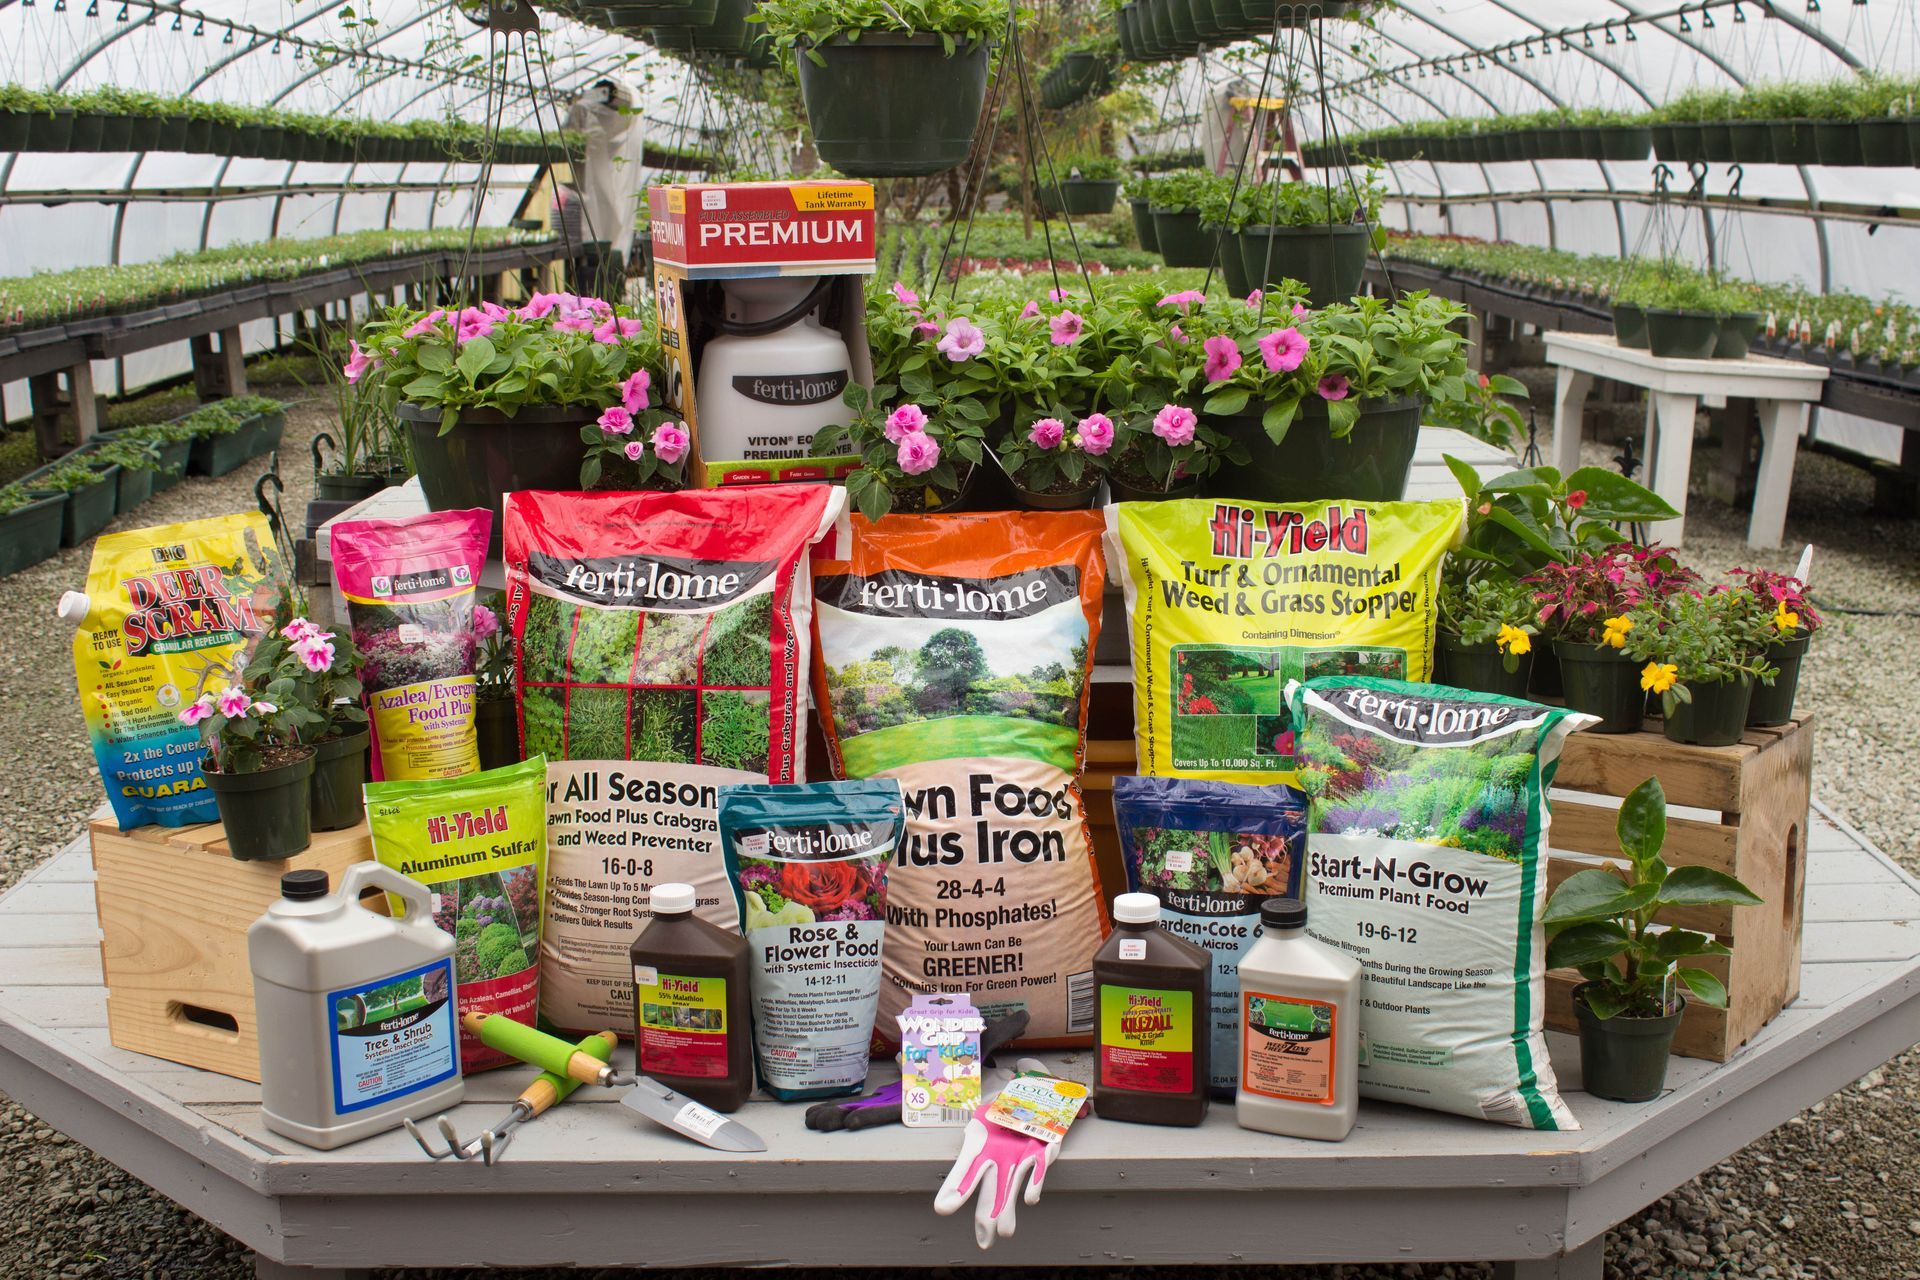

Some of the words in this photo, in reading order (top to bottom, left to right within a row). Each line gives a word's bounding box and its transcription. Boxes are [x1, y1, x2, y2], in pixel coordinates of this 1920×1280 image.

[805, 201, 825, 209] Tank
[827, 199, 867, 209] Warranty
[817, 191, 853, 199] Lifetime
[700, 211, 731, 221] FULLY
[730, 210, 790, 221] ASSEMBLED
[652, 219, 684, 247] PREMIUM
[700, 219, 863, 247] PREMIUM
[744, 449, 804, 460] PREMIUM
[1181, 560, 1231, 588] Turf
[1237, 564, 1257, 588] &
[1264, 561, 1400, 588] Ornamental
[121, 564, 231, 612] DEER
[1161, 580, 1229, 615] Weed
[1235, 591, 1256, 616] &
[1261, 590, 1325, 615] Grass
[1331, 589, 1417, 620] Stopper
[93, 629, 119, 641] READY
[122, 597, 263, 656] SCRAM
[1242, 630, 1288, 640] Containing
[93, 641, 105, 651] TO
[106, 638, 122, 650] USE
[153, 639, 194, 652] GRANULAR
[195, 633, 234, 647] REPELLENT
[785, 662, 794, 687] and
[408, 701, 448, 724] Food
[450, 699, 471, 716] Plus
[136, 718, 176, 731] Environment
[423, 721, 440, 731] with
[781, 690, 794, 752] Crabgrass
[124, 752, 141, 764] 2x
[144, 747, 163, 760] the
[1174, 758, 1197, 767] Covers
[1199, 758, 1208, 768] Up
[1250, 758, 1263, 769] Sq.
[1265, 759, 1277, 768] Ft.
[117, 764, 174, 782] Protects
[177, 760, 194, 774] up
[781, 756, 791, 782] Plus
[122, 777, 208, 798] GUARA
[563, 772, 599, 802] All
[608, 772, 719, 810] Season
[904, 785, 957, 820] wn
[969, 774, 1072, 821] Food
[428, 805, 508, 845] Hi-Yield
[547, 811, 571, 826] awn
[576, 808, 611, 824] Food
[616, 809, 648, 825] Plus
[654, 811, 718, 833] Crabgra
[557, 831, 582, 846] and
[585, 831, 627, 846] Weed
[632, 832, 713, 853] Preventer
[897, 822, 965, 867] lus
[976, 820, 1066, 865] Iron
[401, 852, 487, 875] Aluminum
[602, 857, 653, 877] 16-0-8
[555, 876, 573, 887] Feeds
[574, 878, 587, 888] The
[588, 880, 608, 890] Lawn
[610, 882, 621, 892] Up
[622, 882, 632, 891] To
[633, 883, 639, 891] 5
[1311, 852, 1489, 899] Start-N-Grow
[556, 889, 582, 901] Provides
[583, 892, 630, 905] Season-long
[936, 877, 1006, 900] 28-4-4
[1319, 882, 1374, 899] Premium
[1380, 887, 1421, 906] Plant
[1426, 894, 1470, 914] Food
[556, 901, 578, 913] Creates
[579, 904, 611, 917] Stronger
[612, 907, 631, 917] Root
[886, 905, 929, 928] With
[935, 899, 1057, 931] Phosphates!
[554, 913, 579, 925] Delivers
[581, 917, 602, 928] Quick
[603, 920, 633, 930] Results
[789, 927, 838, 944] Rose
[845, 923, 859, 940] &
[1252, 924, 1263, 938] 6
[1356, 921, 1417, 944] 19-6-12
[765, 943, 830, 963] Flower
[836, 939, 879, 957] Food
[924, 940, 948, 952] Your
[952, 941, 981, 952] Lawn
[985, 939, 1005, 950] Can
[1008, 937, 1022, 947] Be
[1201, 939, 1239, 950] Micros
[1318, 933, 1340, 948] Release
[1341, 940, 1370, 954] Nitrogen
[764, 964, 784, 974] with
[787, 960, 831, 974] Systemic
[834, 959, 878, 969] Insecticide
[923, 953, 1023, 977] GREENER!
[1217, 964, 1239, 975] 12-1
[1385, 963, 1411, 975] During
[1413, 965, 1427, 975] the
[1428, 966, 1463, 978] Growing
[1465, 968, 1493, 976] Season
[662, 978, 699, 993] Hi-Yield
[805, 974, 846, 986] 14-12-11
[892, 976, 937, 993] Contains
[941, 982, 962, 993] Iron
[965, 981, 983, 992] For
[986, 978, 1017, 990] Green
[1021, 973, 1057, 988] Power!
[1371, 974, 1406, 986] Beautiful
[1408, 979, 1452, 990] Landscape
[1454, 982, 1472, 990] Like
[495, 987, 522, 999] Camellias,
[658, 992, 671, 1000] 55%
[672, 994, 704, 1003] Malathion
[1128, 994, 1161, 1007] Hi-Yield
[1372, 1000, 1403, 1012] Outdoor
[1404, 1004, 1431, 1015] Plants
[895, 1015, 988, 1033] WONDER
[365, 1038, 389, 1052] Tree
[392, 1033, 400, 1044] &
[404, 1023, 432, 1041] Shrub
[365, 1047, 393, 1060] Systemic
[394, 1041, 413, 1053] Insect
[414, 1033, 433, 1045] Drench
[920, 1031, 966, 1047] GRIP
[771, 1049, 797, 1058] CAUTION
[905, 1044, 932, 1061] for
[358, 1076, 383, 1088] CAUTION
[911, 1092, 925, 1104] XS
